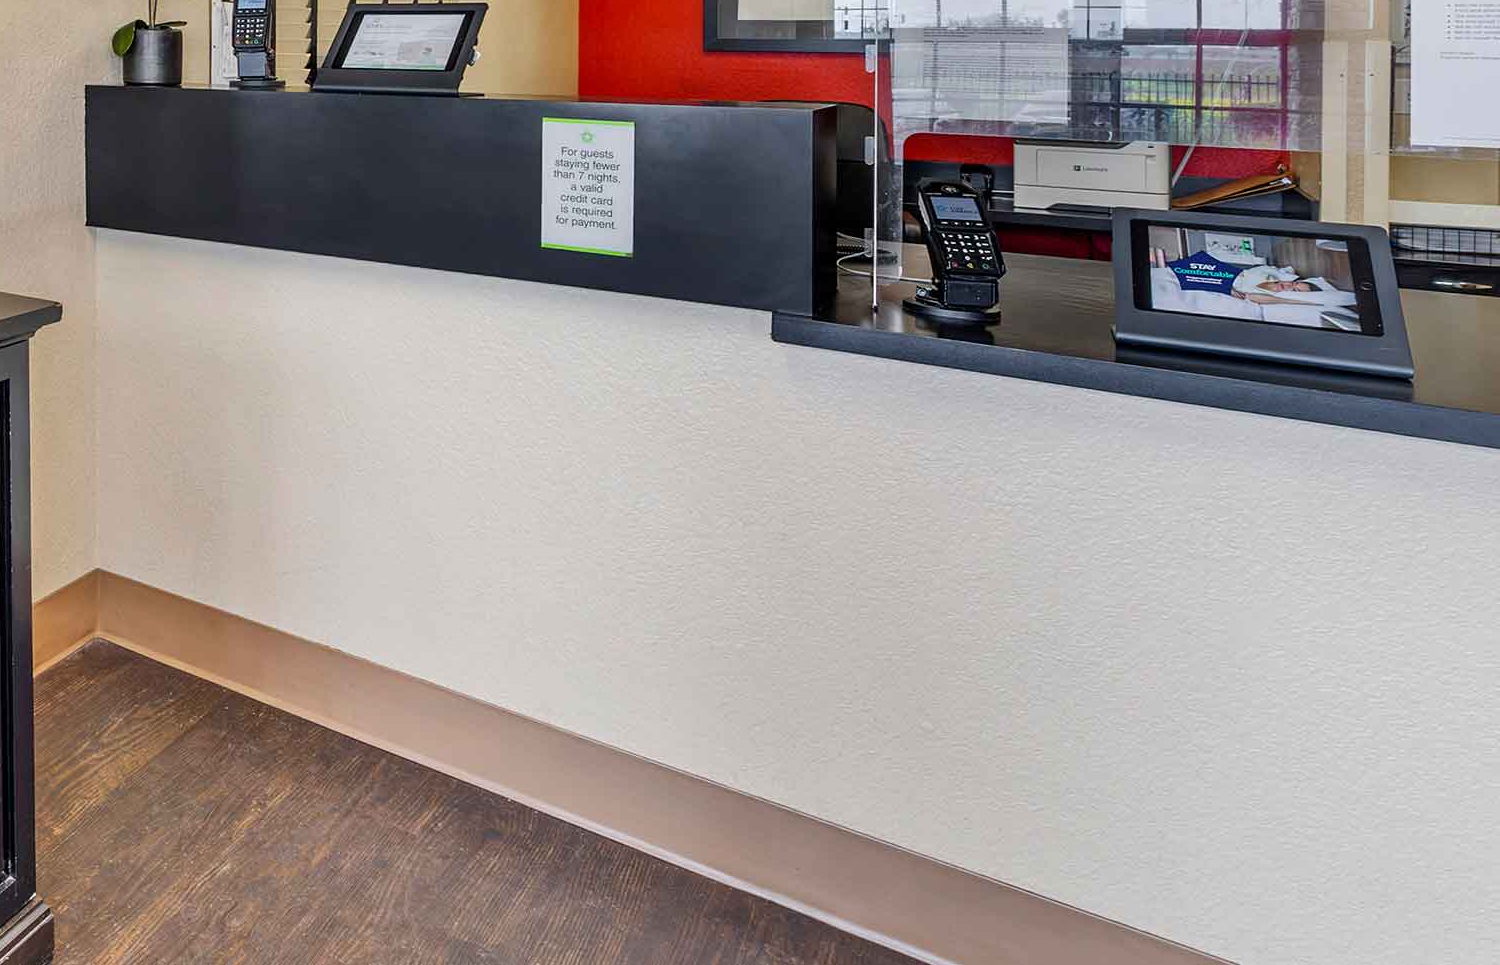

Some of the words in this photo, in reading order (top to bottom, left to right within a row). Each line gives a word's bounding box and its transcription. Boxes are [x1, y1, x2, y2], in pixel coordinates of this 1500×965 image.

[561, 146, 578, 157] For
[580, 149, 614, 159] guests
[555, 158, 590, 170] staying
[592, 161, 621, 171] fewer
[554, 170, 576, 180] than
[578, 171, 585, 180] 7
[570, 184, 577, 192] a
[580, 183, 604, 194] valid
[560, 194, 588, 204] credit
[590, 196, 613, 206] card
[560, 204, 569, 214] is
[571, 206, 613, 218] required
[555, 215, 569, 225] for
[1174, 267, 1235, 279] Comfortable
[1189, 263, 1216, 271] STAY
